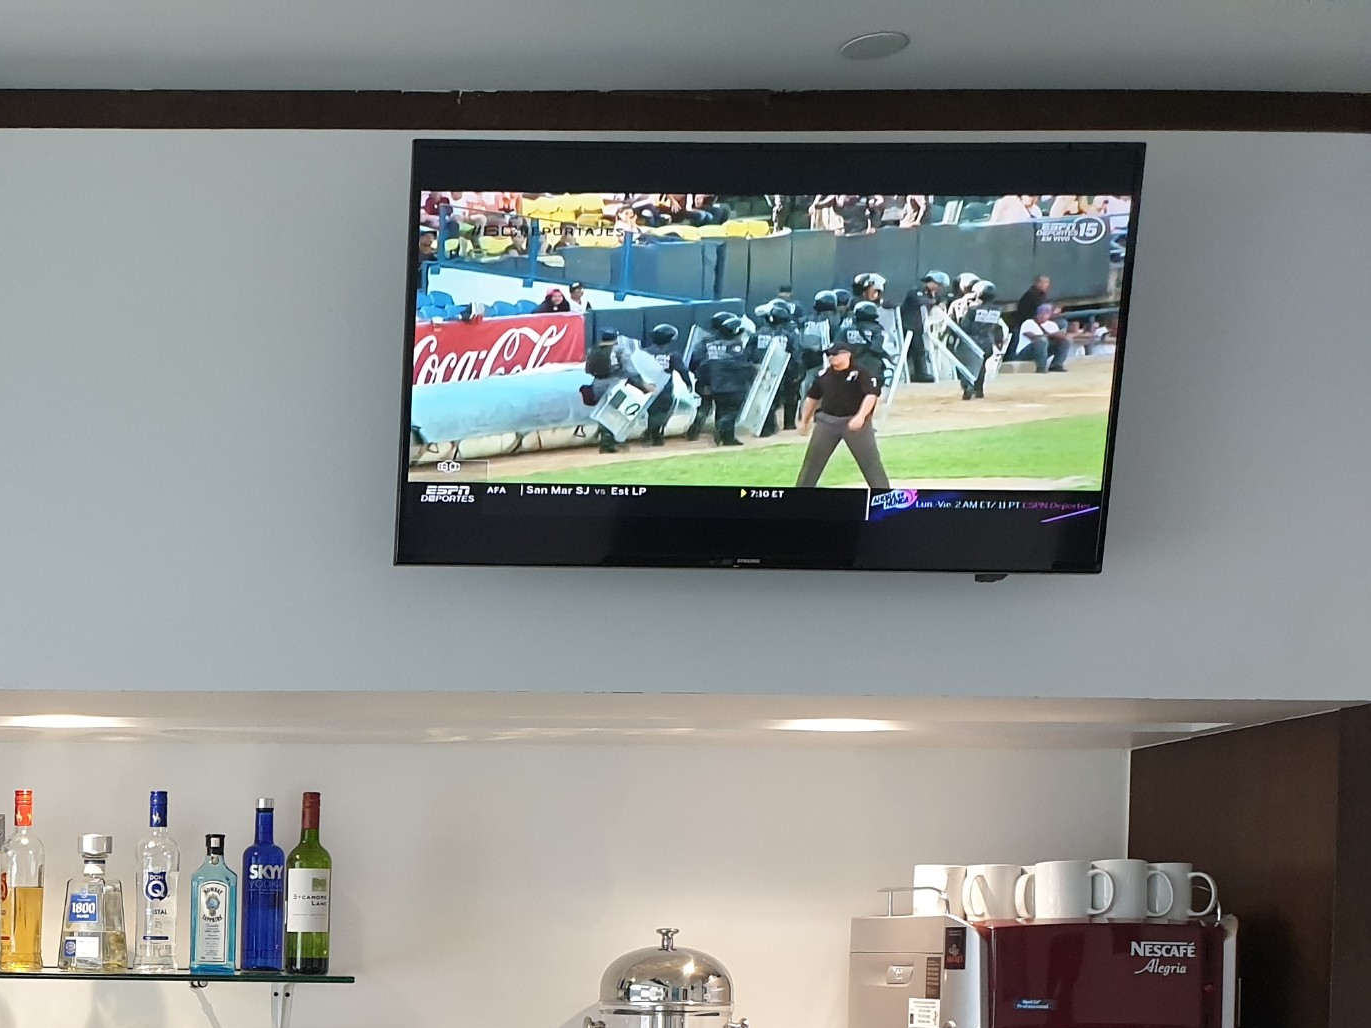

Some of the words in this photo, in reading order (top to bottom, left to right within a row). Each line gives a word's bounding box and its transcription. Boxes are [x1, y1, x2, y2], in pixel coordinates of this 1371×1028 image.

[1078, 222, 1099, 237] 15
[426, 485, 470, 495] ESPN
[487, 486, 506, 494] AFA
[526, 486, 548, 495] San
[551, 486, 573, 495] Mar
[575, 486, 590, 496] SJ
[594, 488, 606, 496] vs
[611, 487, 629, 496] Est
[632, 487, 647, 496] LP
[750, 490, 770, 498] 7:10
[772, 490, 785, 498] ET
[420, 495, 475, 503] DEPORTES
[962, 501, 978, 509] AM
[249, 865, 283, 880] SKYY
[147, 881, 166, 899] Q
[72, 902, 96, 914] 1800
[1130, 941, 1196, 957] NESCAFÉ
[1134, 958, 1187, 976] Alegria
